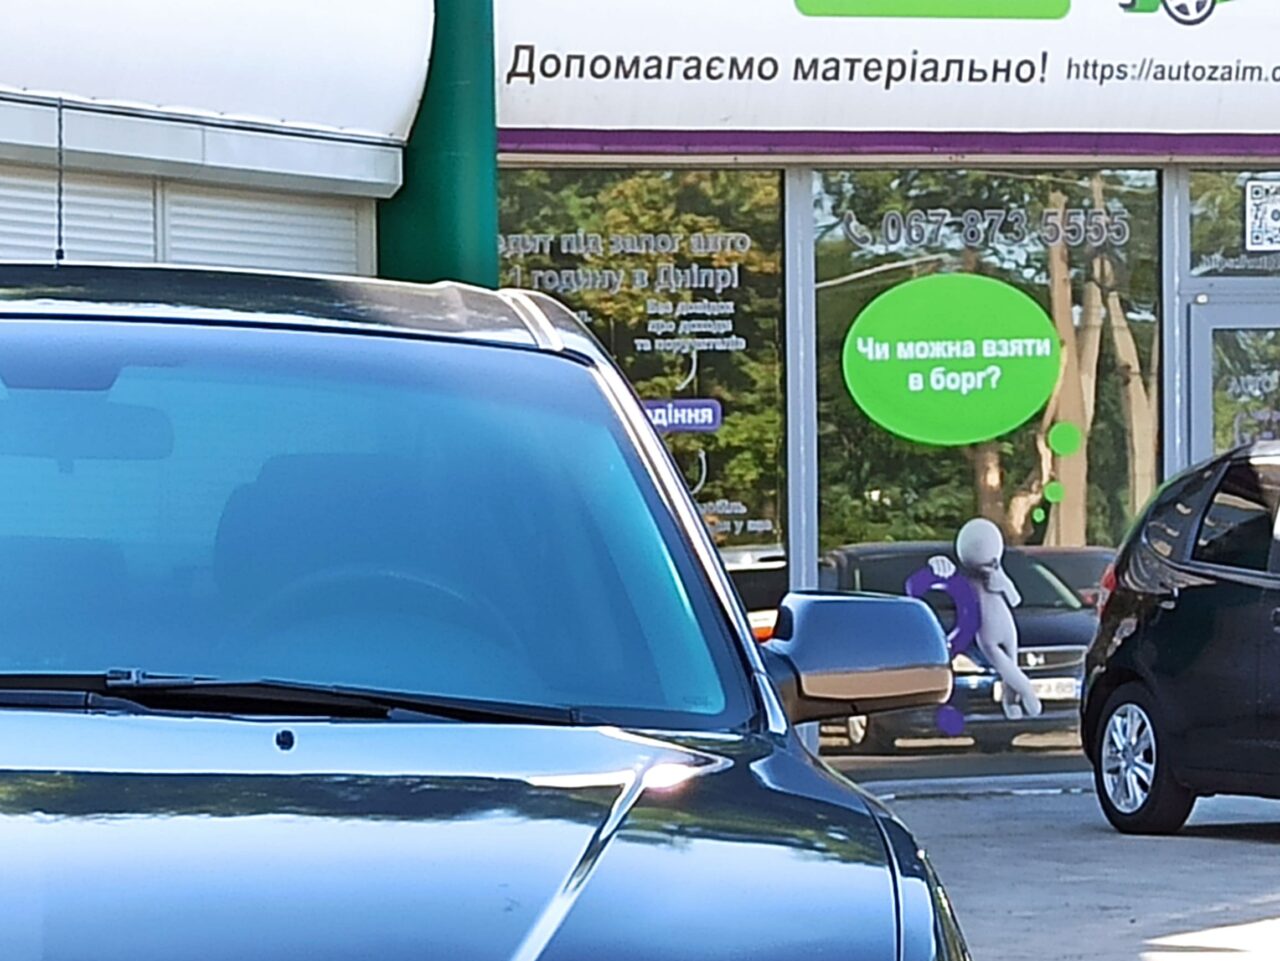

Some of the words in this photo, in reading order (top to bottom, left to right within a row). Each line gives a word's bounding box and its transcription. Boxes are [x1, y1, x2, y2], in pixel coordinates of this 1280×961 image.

[506, 44, 779, 85] Допомагаємо
[792, 50, 1048, 90] матеріально!
[881, 208, 948, 246] 067
[961, 208, 1026, 246] 873
[1040, 208, 1129, 246] 5555
[857, 337, 890, 360] Чи
[896, 340, 975, 359] можна
[982, 338, 1051, 358] взяти
[908, 373, 924, 391] в
[930, 365, 1001, 395] борг?
[646, 403, 714, 427] діння
